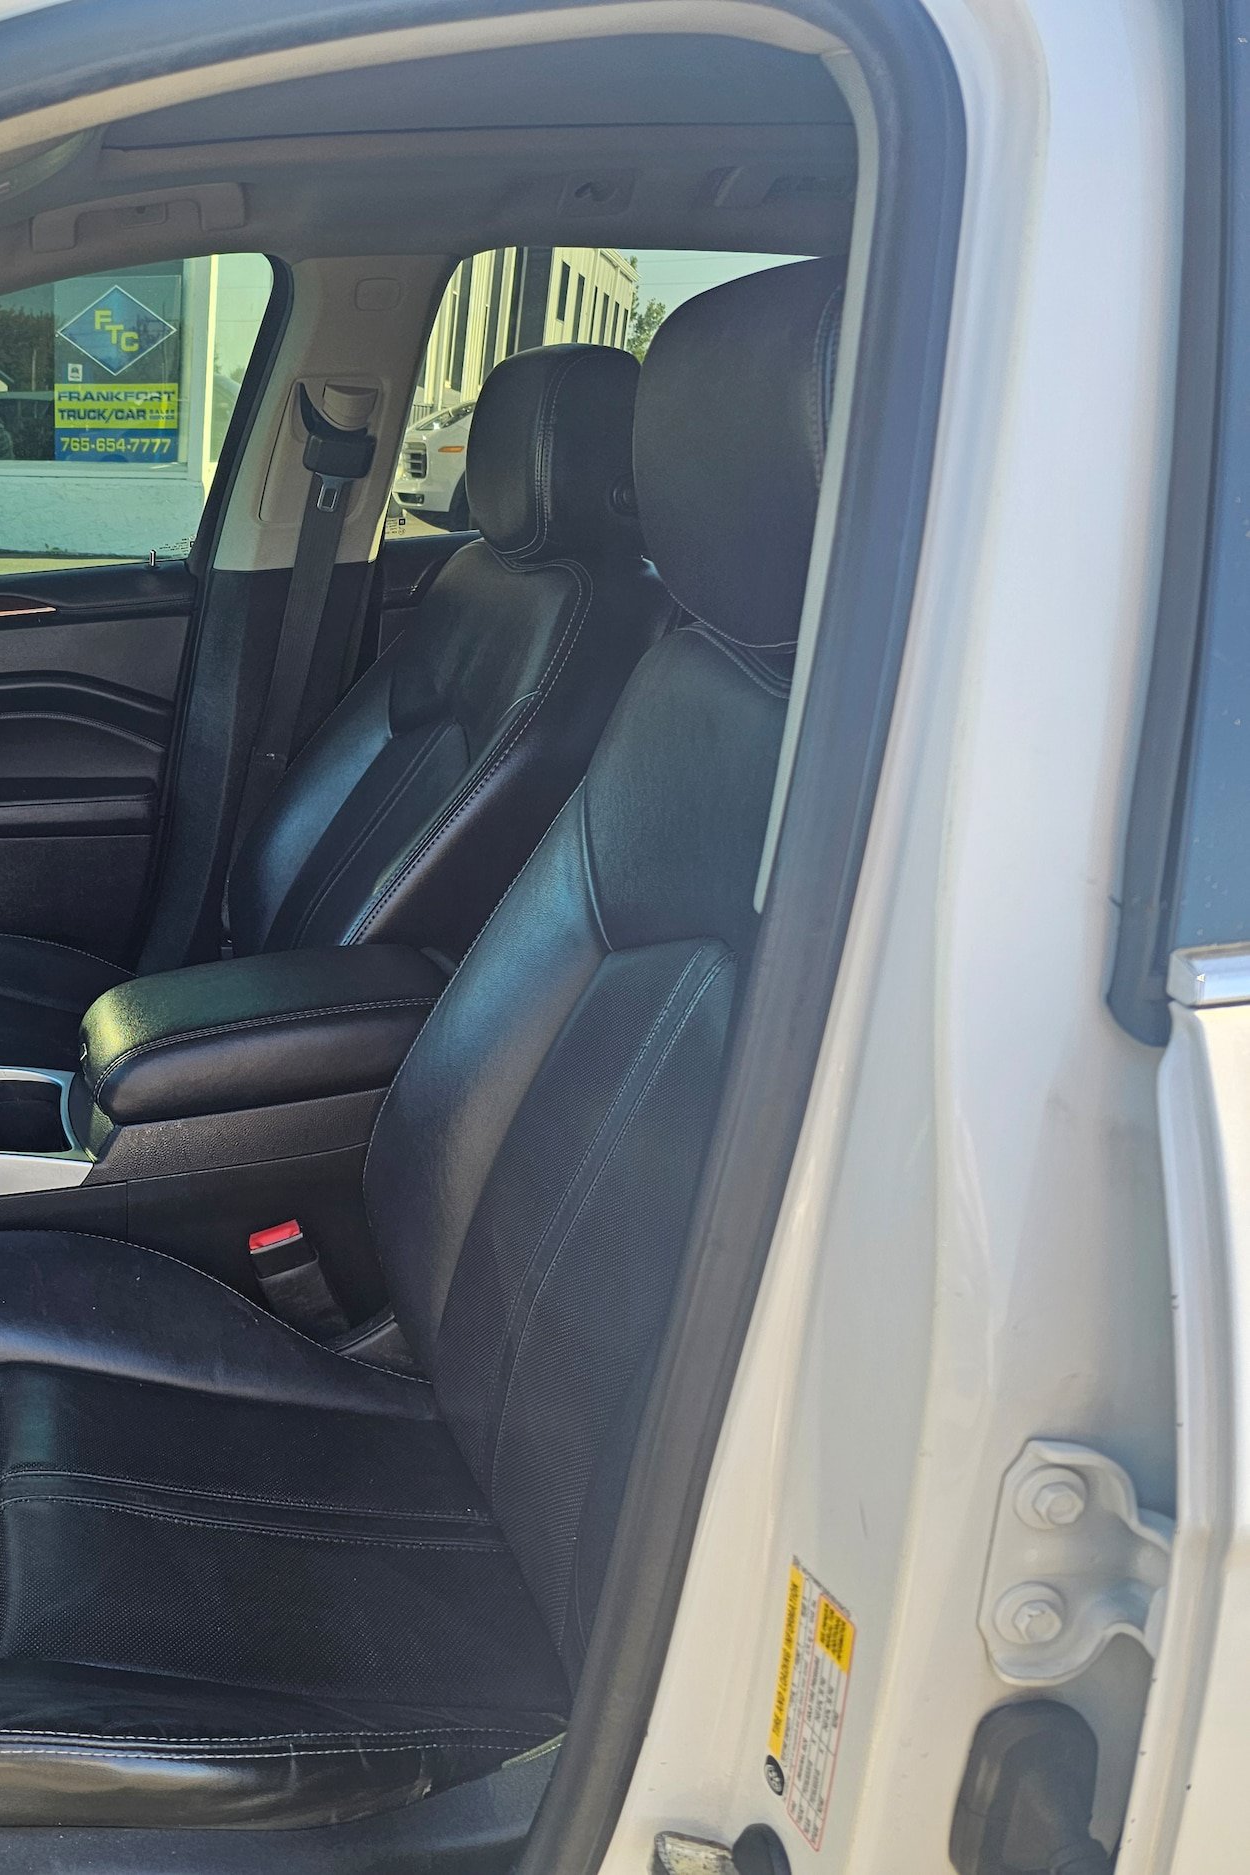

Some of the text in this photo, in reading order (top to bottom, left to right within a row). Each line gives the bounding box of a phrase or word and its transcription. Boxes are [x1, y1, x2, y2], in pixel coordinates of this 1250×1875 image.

[93, 309, 140, 353] FTC
[57, 390, 175, 403] FRANKFORT
[58, 408, 147, 423] TRUCK/CAR
